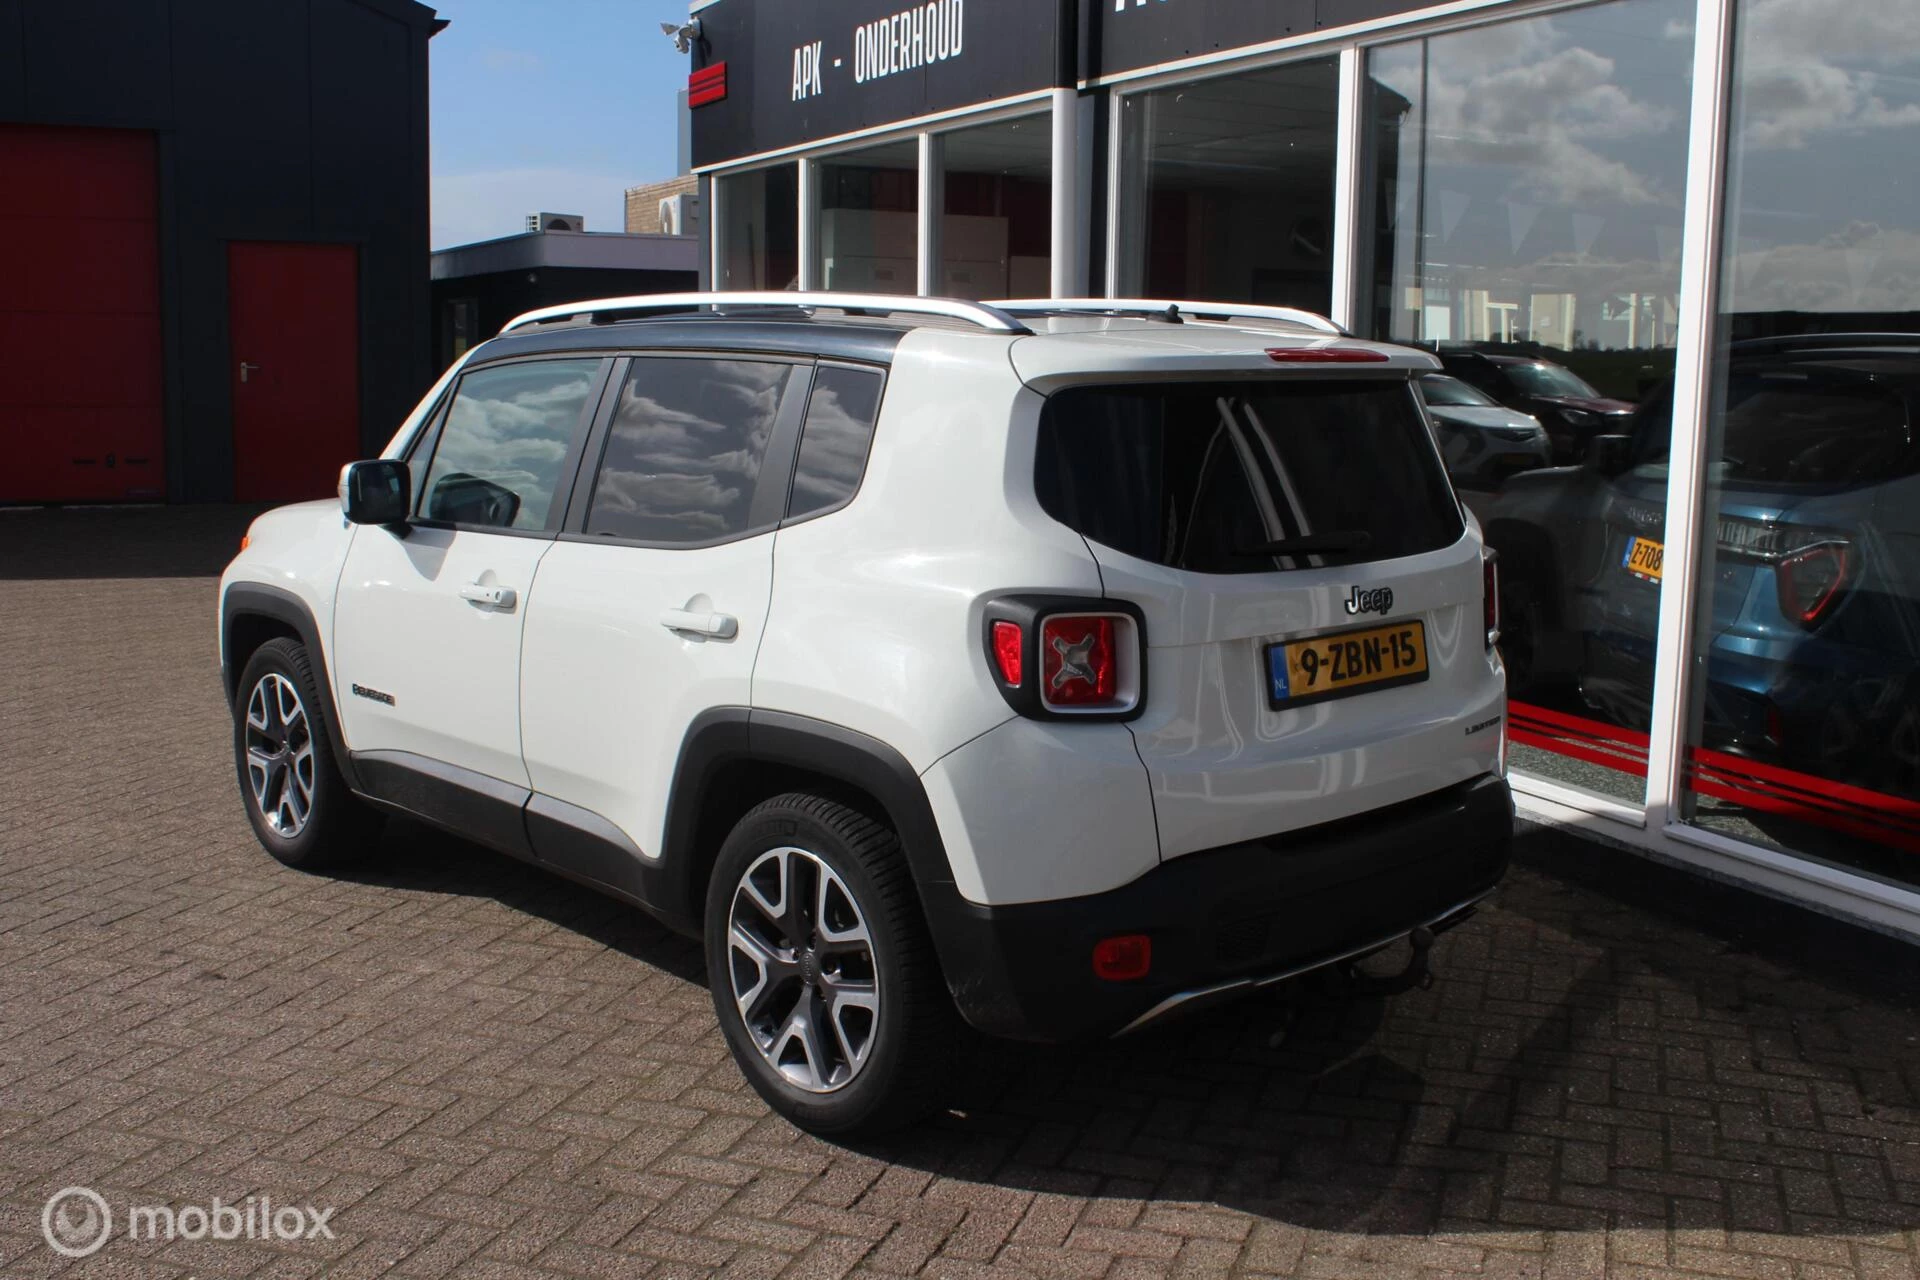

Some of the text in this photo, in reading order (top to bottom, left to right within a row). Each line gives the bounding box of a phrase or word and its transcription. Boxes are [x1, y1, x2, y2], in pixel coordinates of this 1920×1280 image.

[792, 41, 822, 101] APK
[855, 0, 963, 84] ONDERHOUD
[1345, 585, 1393, 614] Jeep
[1275, 631, 1418, 690] NL 9-ZBN-15
